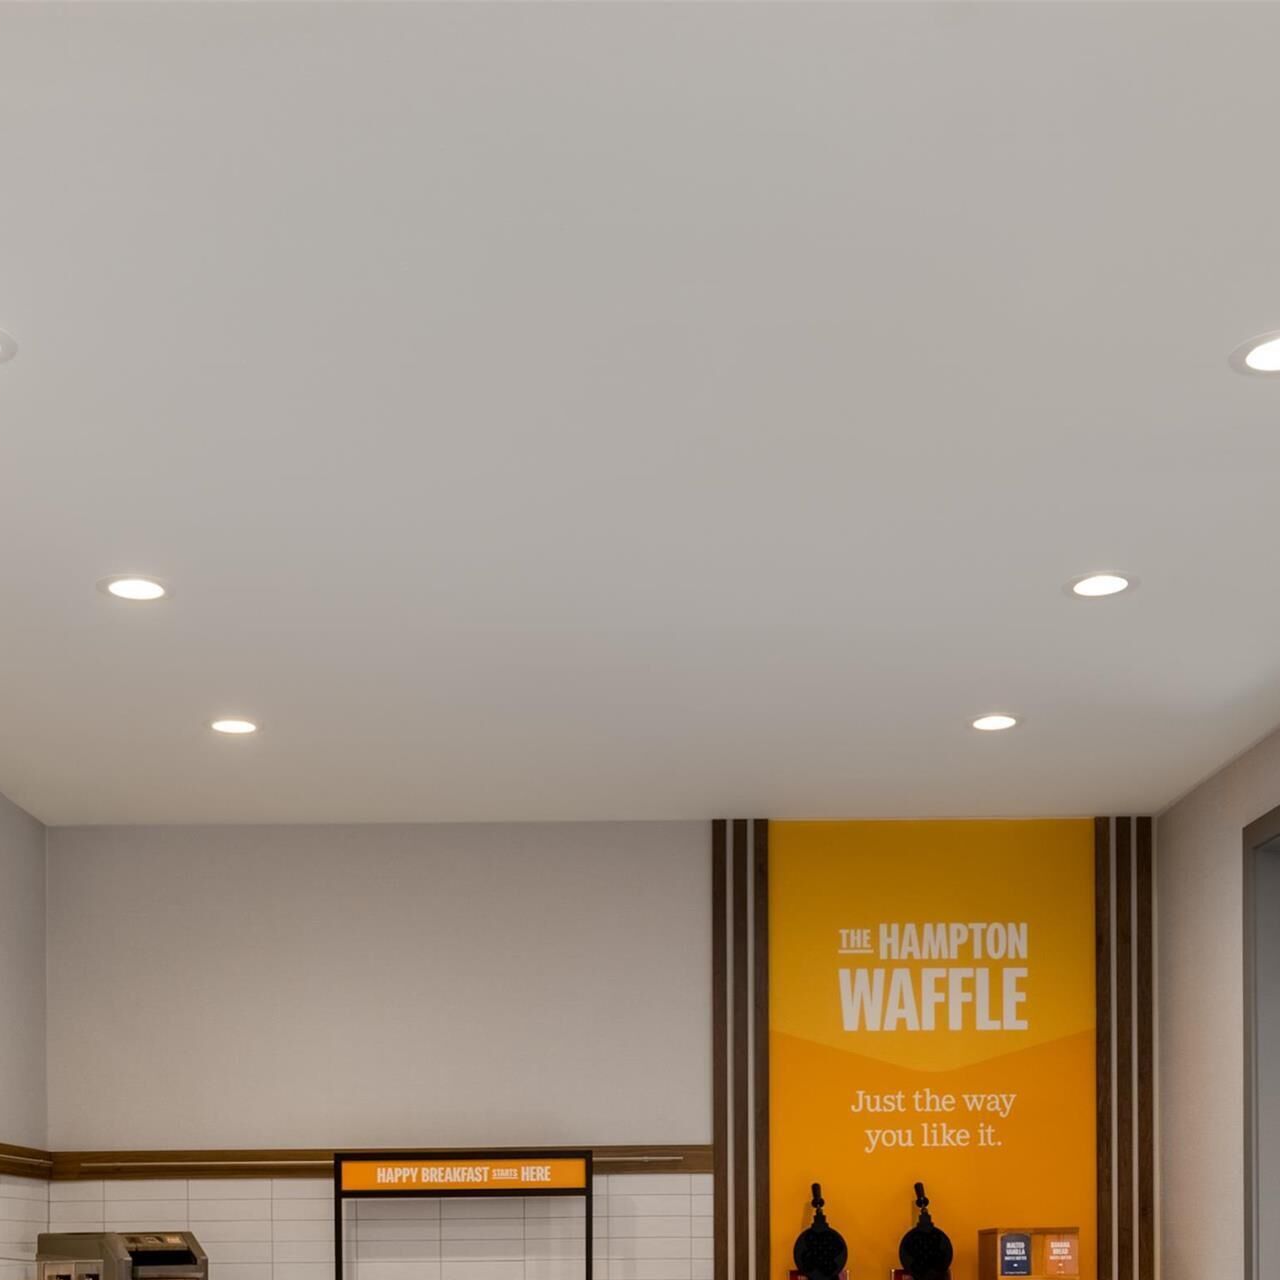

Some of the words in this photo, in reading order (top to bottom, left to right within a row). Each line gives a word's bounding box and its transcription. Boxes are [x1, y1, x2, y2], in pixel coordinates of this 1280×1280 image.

[839, 929, 871, 949] THE
[879, 922, 1028, 960] HAMPTON
[838, 967, 1029, 1031] WAFFLE
[851, 1090, 906, 1113] Just
[913, 1088, 956, 1113] the
[962, 1093, 1017, 1118] way
[865, 1129, 914, 1153] you
[921, 1123, 971, 1147] like
[978, 1122, 1002, 1147] it.
[376, 1167, 418, 1184] HAPPY
[422, 1166, 489, 1183] BREAKFAST
[492, 1168, 518, 1178] STARTS
[521, 1166, 551, 1182] HERE
